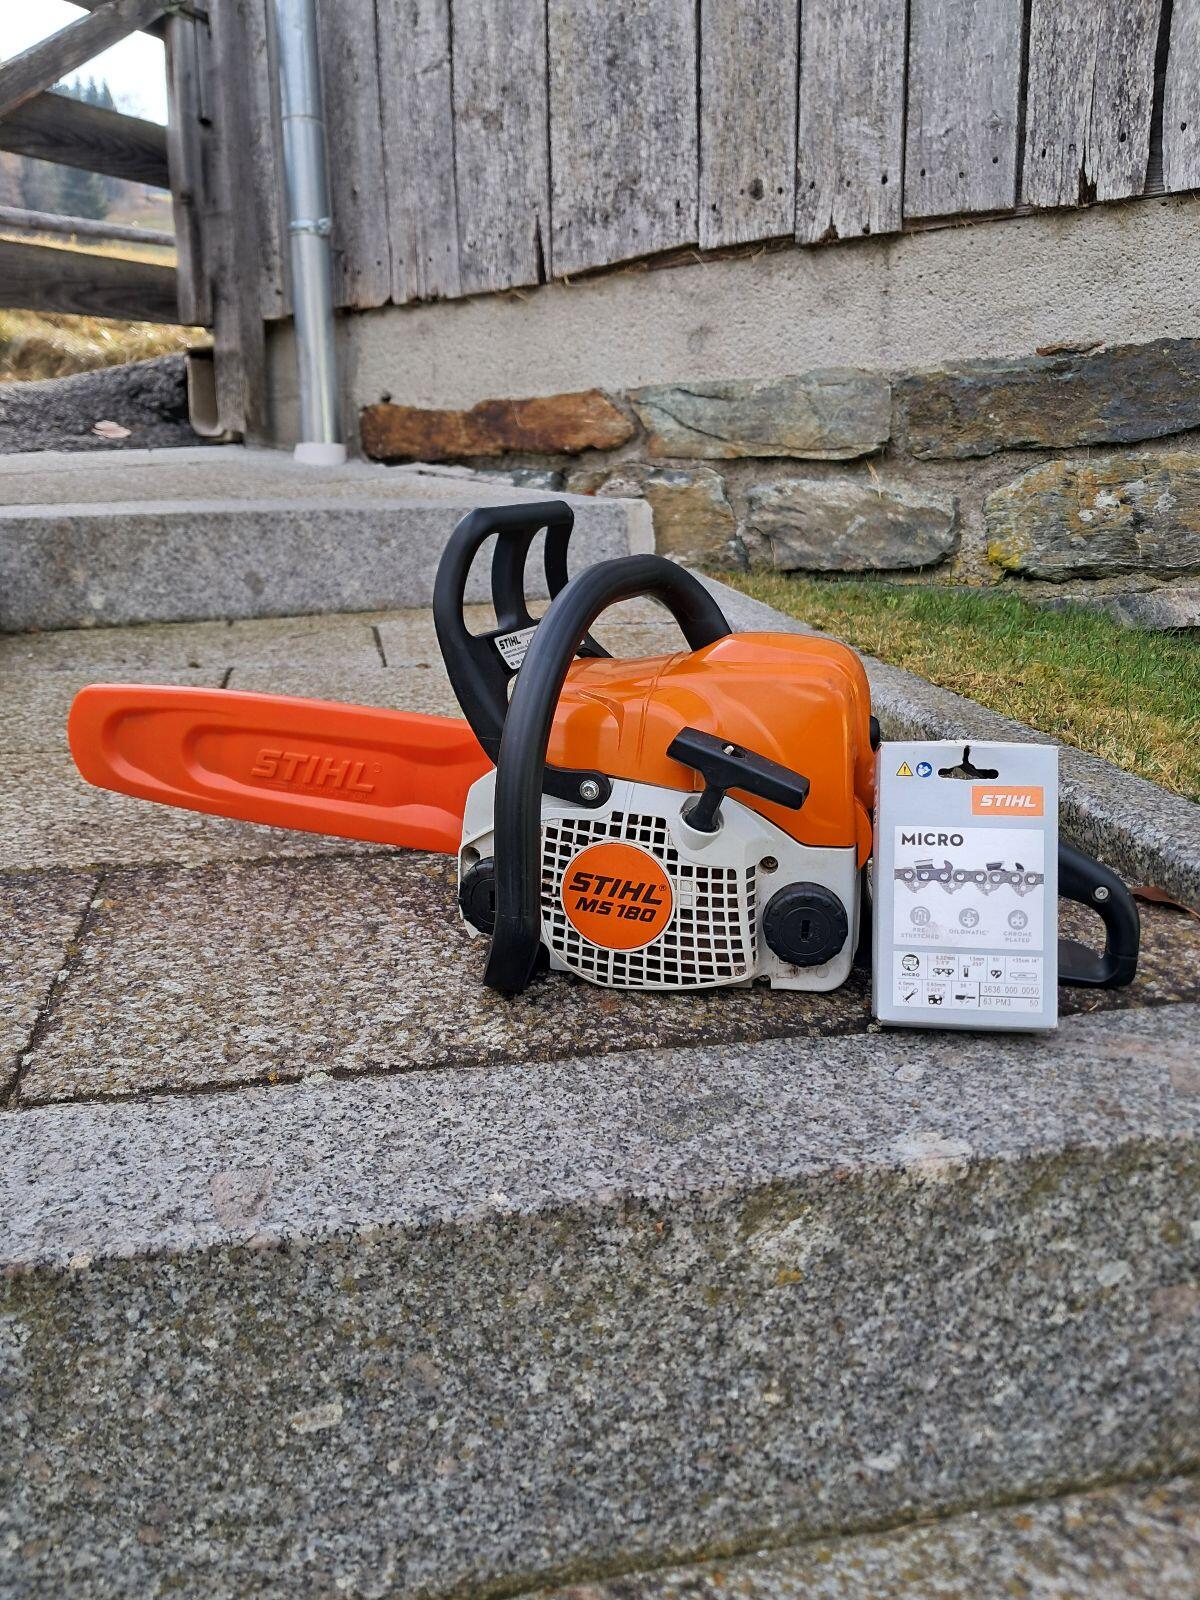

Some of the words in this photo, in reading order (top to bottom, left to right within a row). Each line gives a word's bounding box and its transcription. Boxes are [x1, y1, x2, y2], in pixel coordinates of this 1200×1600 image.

[499, 635, 521, 650] STIHL
[251, 748, 375, 793] STIHL
[980, 794, 1036, 808] STIHL
[901, 832, 964, 847] MICRO
[568, 871, 663, 906] STIHL
[575, 896, 615, 916] MS
[617, 904, 657, 923] 180
[983, 985, 1001, 994] 3636
